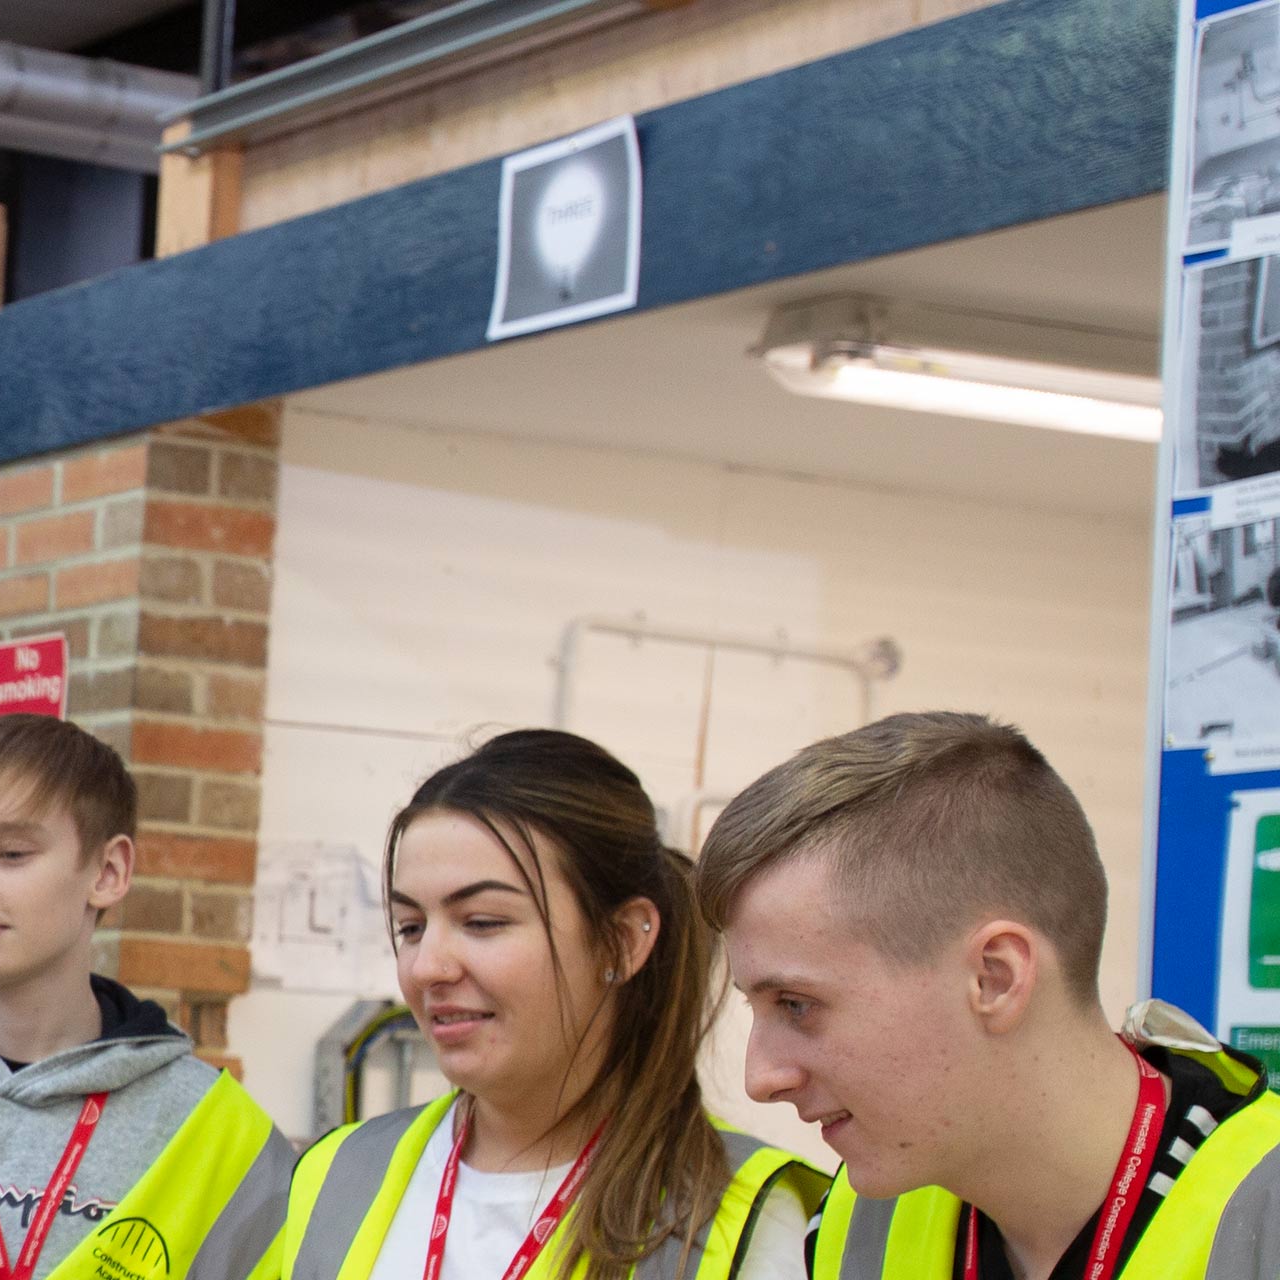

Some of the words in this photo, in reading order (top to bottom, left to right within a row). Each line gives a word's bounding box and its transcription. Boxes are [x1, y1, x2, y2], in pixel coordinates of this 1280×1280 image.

[14, 647, 40, 671] No
[1134, 1102, 1157, 1154] Newcastle
[1117, 1156, 1142, 1195] College
[1097, 1197, 1127, 1261] Construction
